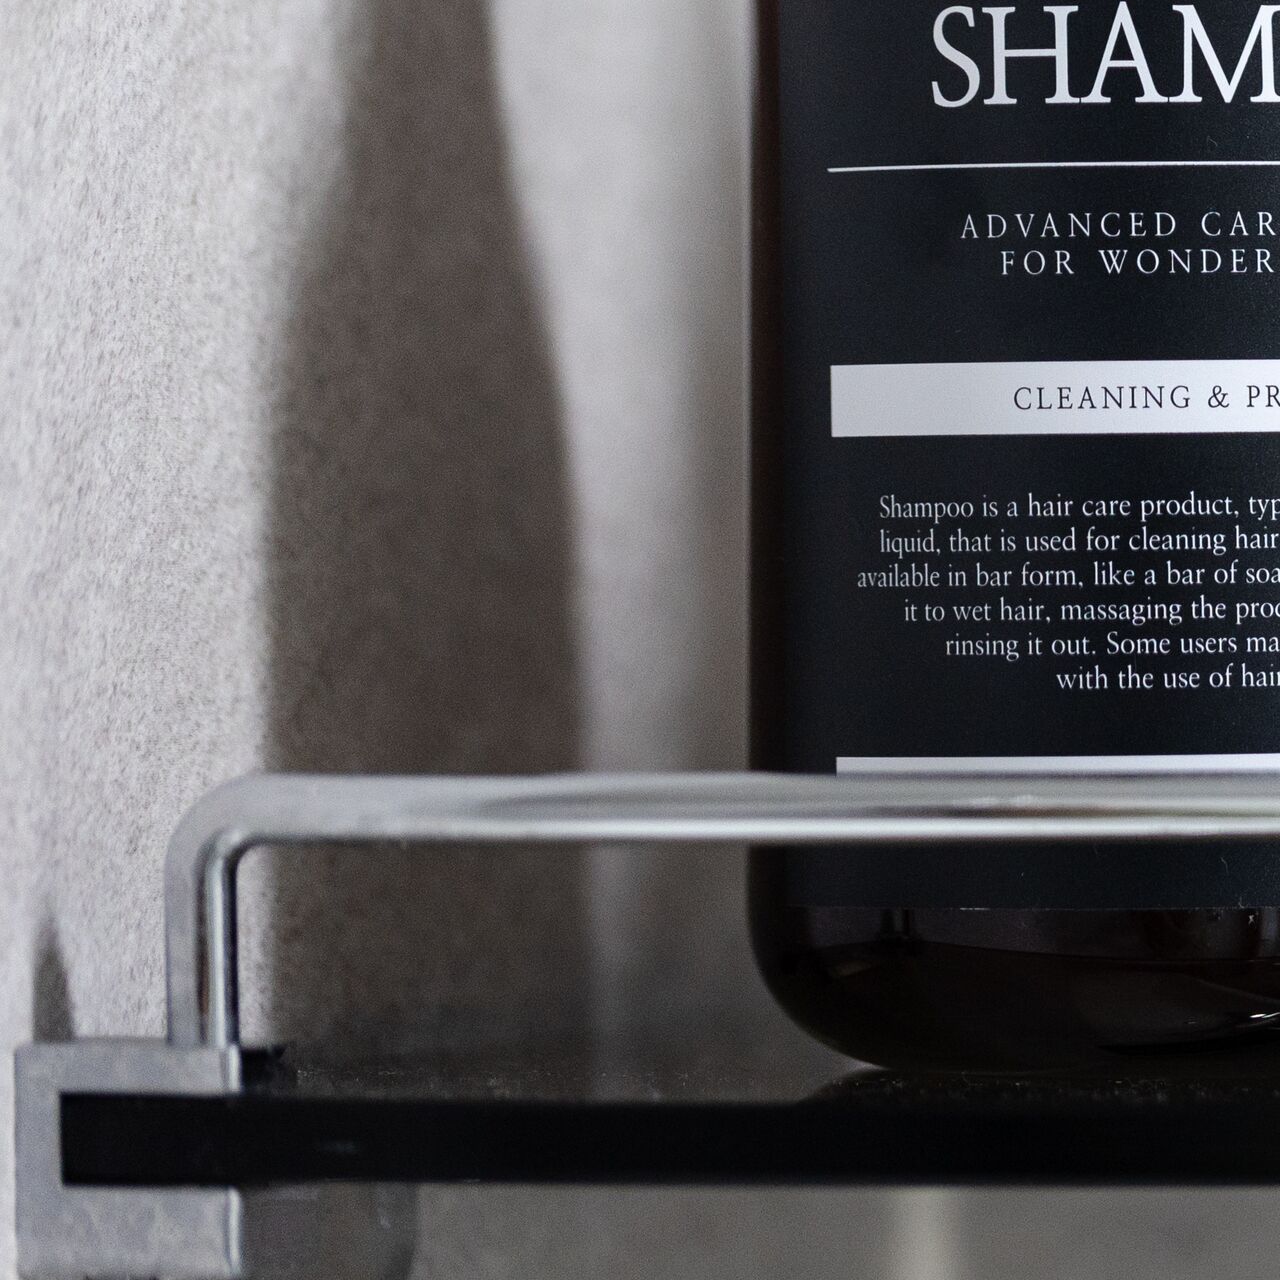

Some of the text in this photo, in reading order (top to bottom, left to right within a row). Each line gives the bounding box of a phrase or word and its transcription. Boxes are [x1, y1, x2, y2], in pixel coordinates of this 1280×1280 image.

[960, 211, 1177, 239] ADVANCED
[1000, 249, 1075, 276] FOR
[1013, 385, 1190, 411] CLEANING
[1207, 384, 1231, 409] &
[879, 493, 975, 525] Shampoo
[982, 493, 999, 519] is
[1006, 501, 1019, 518] a
[1028, 492, 1073, 517] hair
[1081, 499, 1131, 517] care
[1140, 490, 1240, 523] product,
[879, 527, 941, 560] liquid,
[949, 527, 992, 553] that
[1000, 528, 1017, 552] is
[1025, 526, 1077, 552] used
[1086, 525, 1121, 551] for
[1128, 525, 1227, 556] cleaning
[857, 562, 941, 588] available
[948, 563, 967, 587] in
[975, 561, 1013, 587] bar
[1021, 561, 1084, 588] form,
[1093, 560, 1135, 586] like
[1143, 568, 1157, 586] a
[1166, 559, 1206, 585] bar
[1213, 558, 1239, 584] of
[904, 598, 918, 622] it
[924, 603, 946, 622] to
[952, 603, 992, 622] wet
[999, 596, 1051, 623] hair,
[1060, 596, 1183, 626] massaging
[1191, 594, 1227, 620] the
[945, 632, 1020, 662] rinsing
[1027, 632, 1043, 656] it
[1051, 636, 1096, 656] out.
[1106, 630, 1171, 655] Some
[1180, 636, 1238, 654] users
[1055, 664, 1108, 690] with
[1118, 664, 1154, 690] the
[1163, 672, 1201, 689] use
[1208, 662, 1234, 688] of
